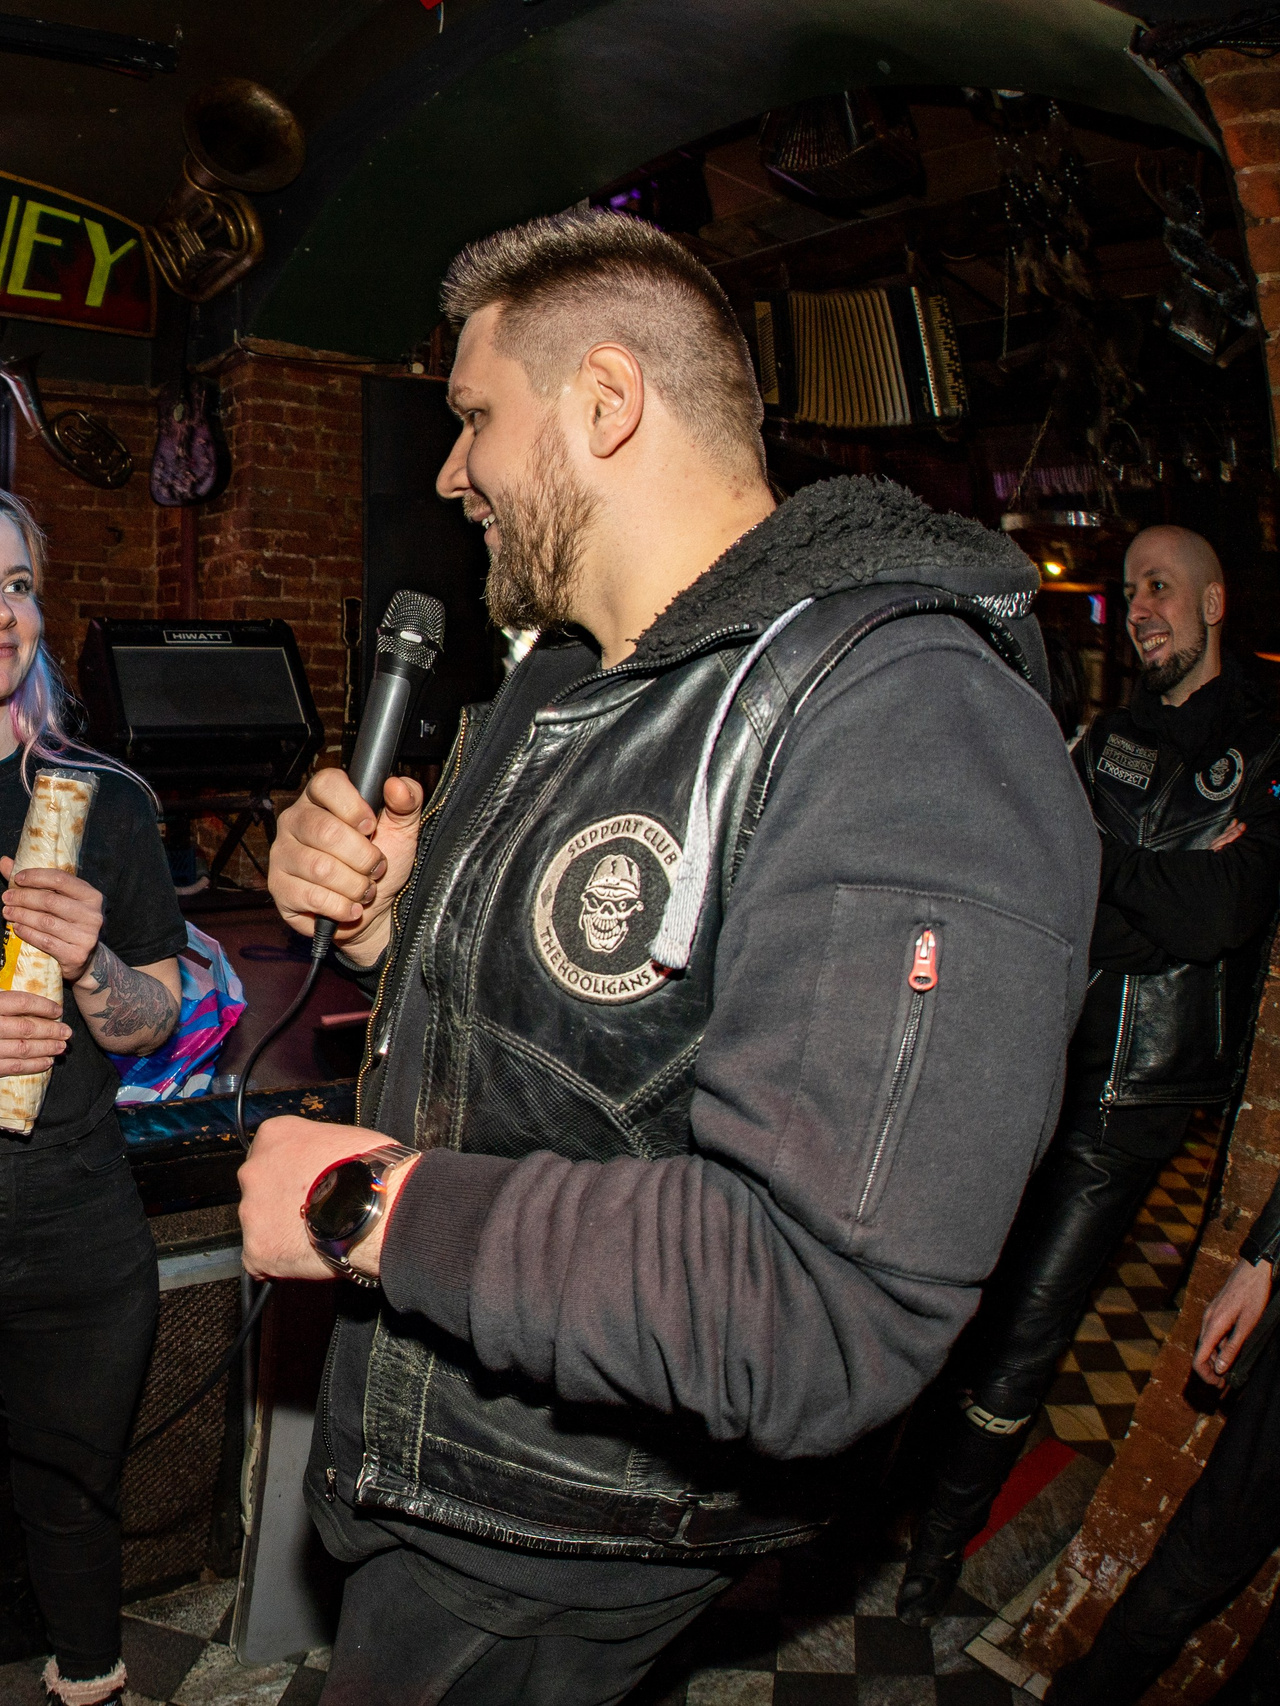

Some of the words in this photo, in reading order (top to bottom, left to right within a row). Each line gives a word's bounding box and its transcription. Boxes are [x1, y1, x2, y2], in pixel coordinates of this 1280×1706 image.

[172, 632, 224, 642] HIWATT
[1104, 761, 1144, 785] PROSPECT
[567, 819, 643, 857] SUPPORT
[643, 827, 678, 866] CLUB
